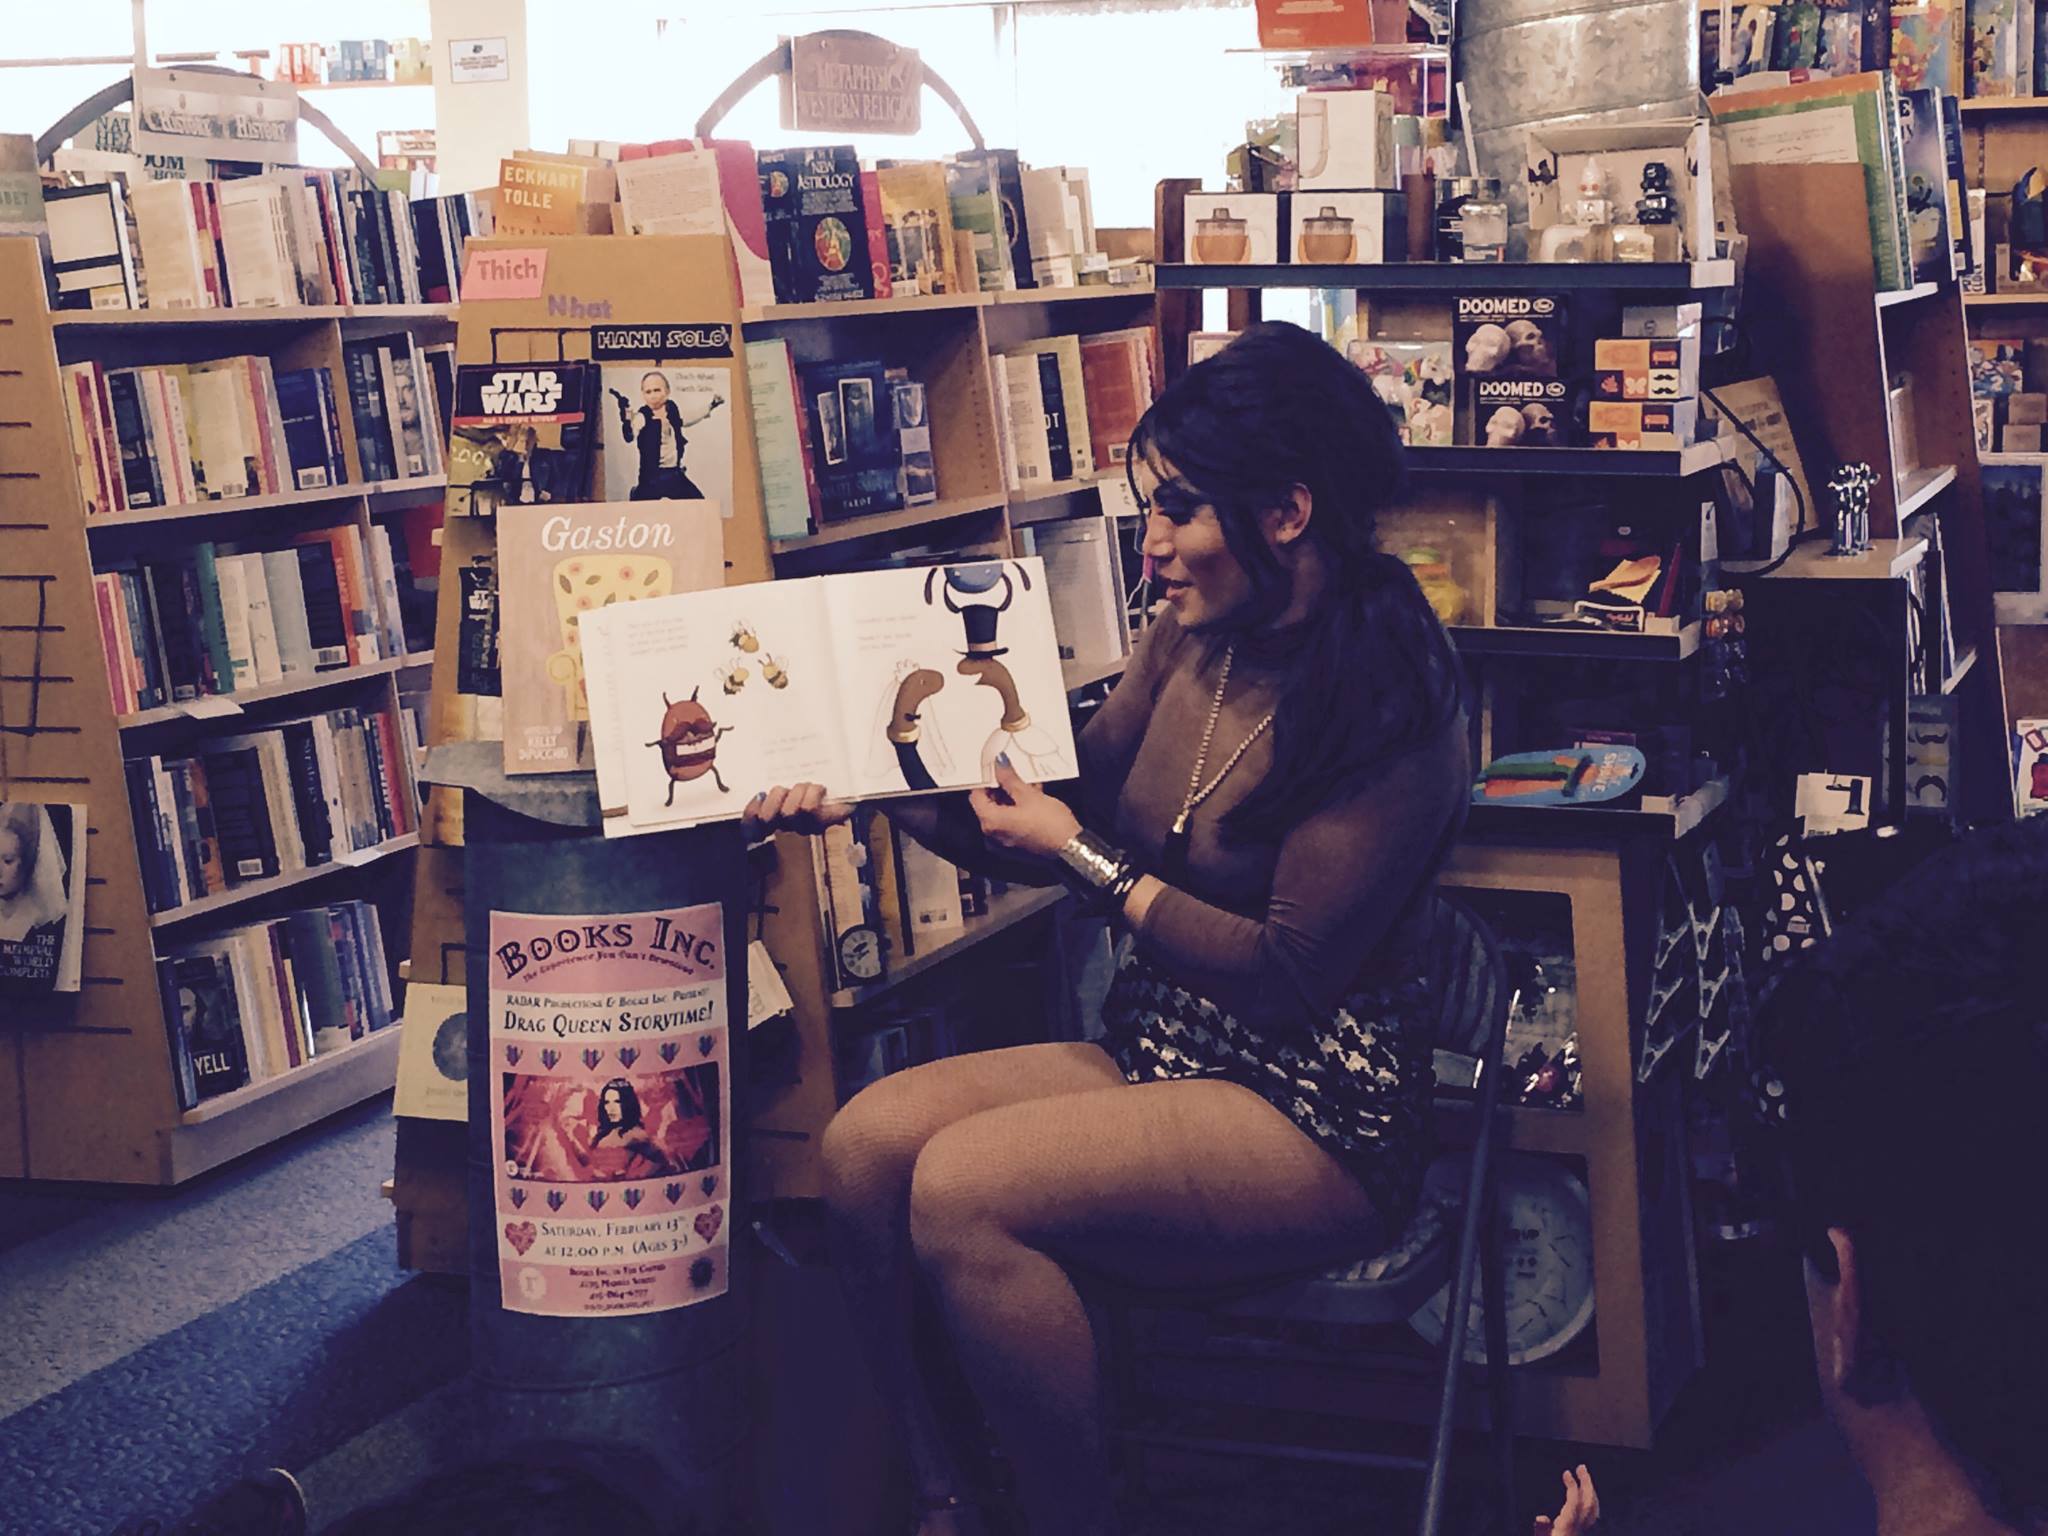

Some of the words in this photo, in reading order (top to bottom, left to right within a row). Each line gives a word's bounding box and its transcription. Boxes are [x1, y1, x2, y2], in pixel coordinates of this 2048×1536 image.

[504, 166, 579, 189] ECKHART
[503, 188, 553, 209] TOLLE
[477, 257, 539, 280] Thich
[548, 294, 613, 319] Nhat
[1458, 298, 1531, 314] DOOMED
[598, 331, 661, 349] HANH
[666, 329, 725, 347] SOLO
[481, 371, 562, 393] STAR
[1479, 381, 1544, 398] DOOMED
[480, 392, 562, 415] WARS
[541, 515, 676, 551] Gaston
[495, 923, 634, 980] BOOKS
[649, 917, 717, 970] INC.
[505, 993, 541, 1008] RADAR
[503, 1010, 546, 1033] DRAG
[552, 1012, 613, 1038] QUEEN
[618, 1000, 715, 1033] STORYTIME!
[194, 1053, 231, 1077] YELL
[606, 1221, 663, 1237] FEBRUARY
